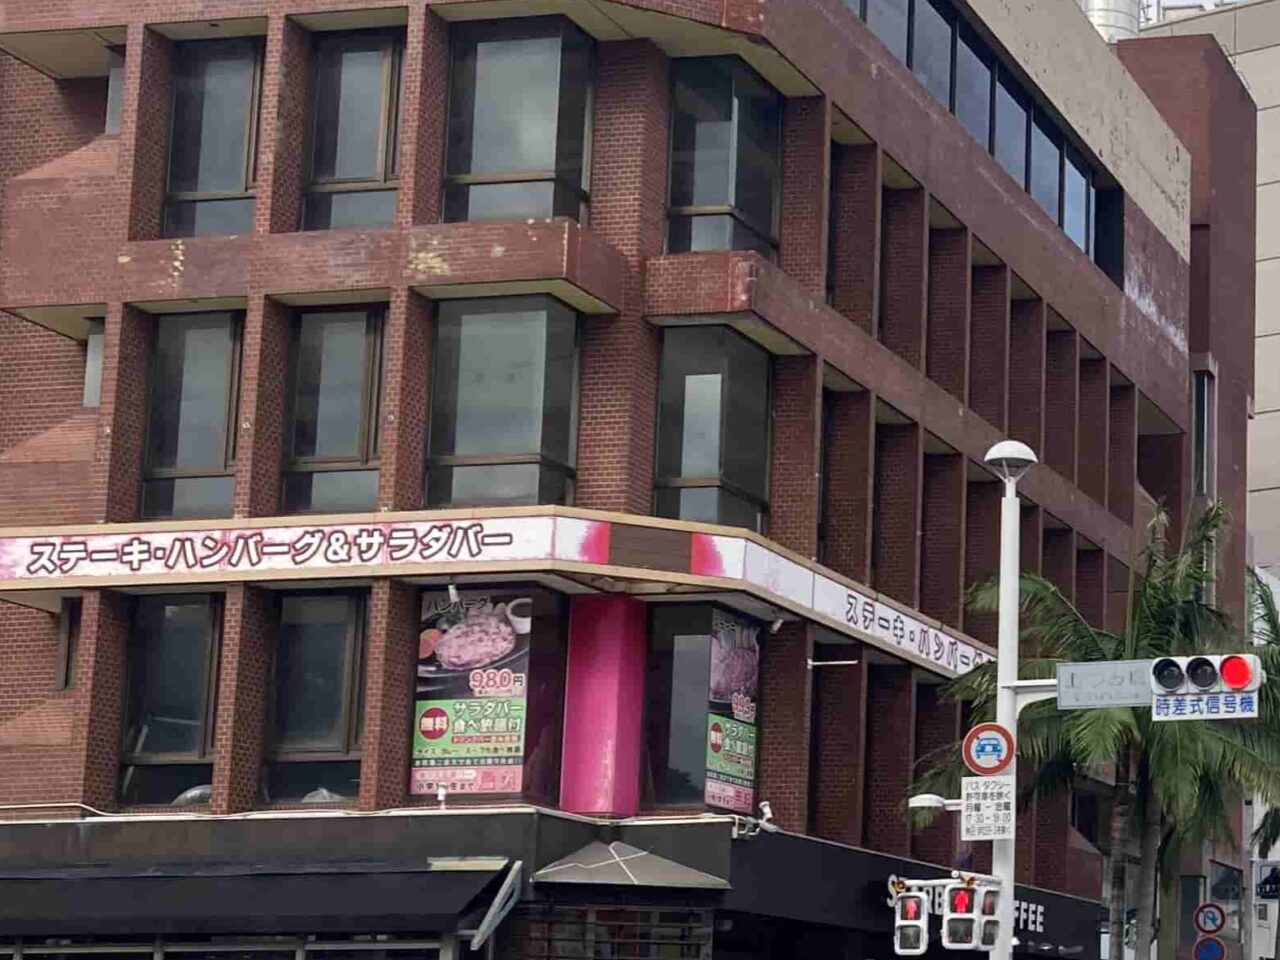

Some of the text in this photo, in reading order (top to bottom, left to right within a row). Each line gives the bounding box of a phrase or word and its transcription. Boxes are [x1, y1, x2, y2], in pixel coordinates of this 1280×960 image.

[1155, 695, 1255, 716] 時差式信号機
